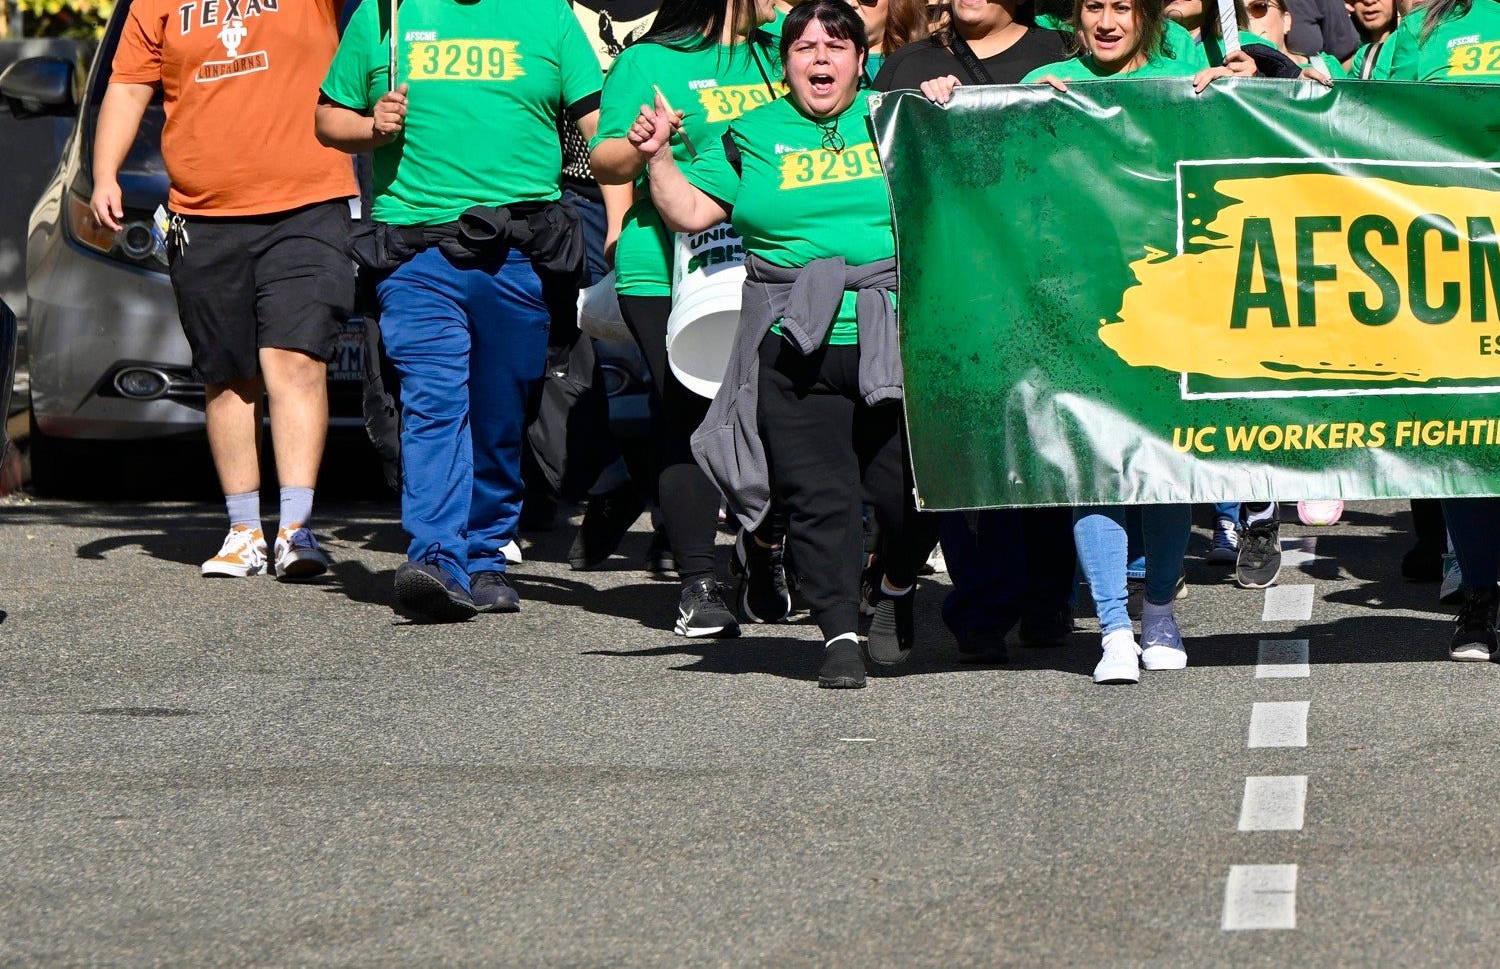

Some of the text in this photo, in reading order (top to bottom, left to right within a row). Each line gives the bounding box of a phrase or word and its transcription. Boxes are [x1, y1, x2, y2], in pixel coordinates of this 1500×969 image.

[405, 31, 438, 41] AFSCME
[1447, 35, 1480, 49] AFSCME
[423, 45, 504, 78] 3299
[1172, 427, 1216, 454] UC
[1225, 422, 1386, 452] WORKERS
